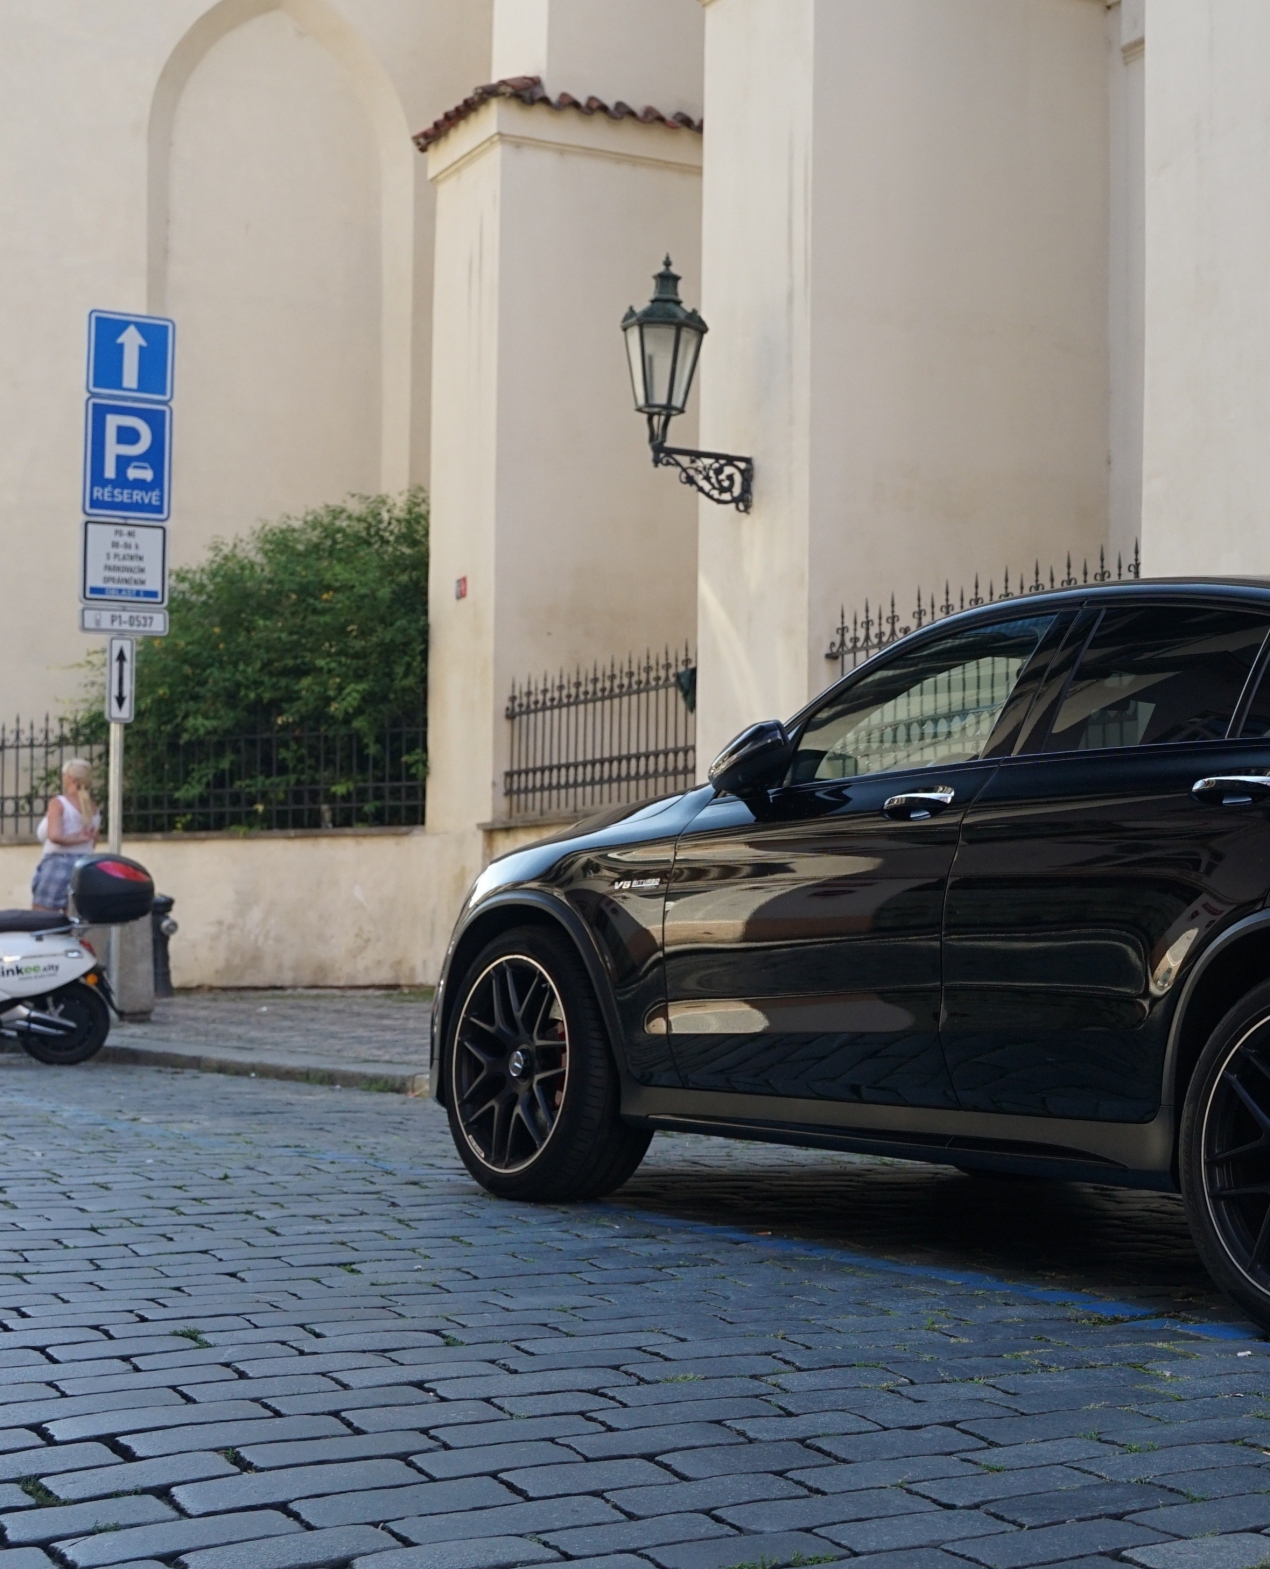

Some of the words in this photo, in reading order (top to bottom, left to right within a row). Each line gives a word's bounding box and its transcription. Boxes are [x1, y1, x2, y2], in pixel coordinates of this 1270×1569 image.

[104, 413, 153, 480] P
[92, 484, 161, 506] RÉSERVÉ
[110, 613, 154, 628] P1-0537
[614, 881, 631, 890] V8
